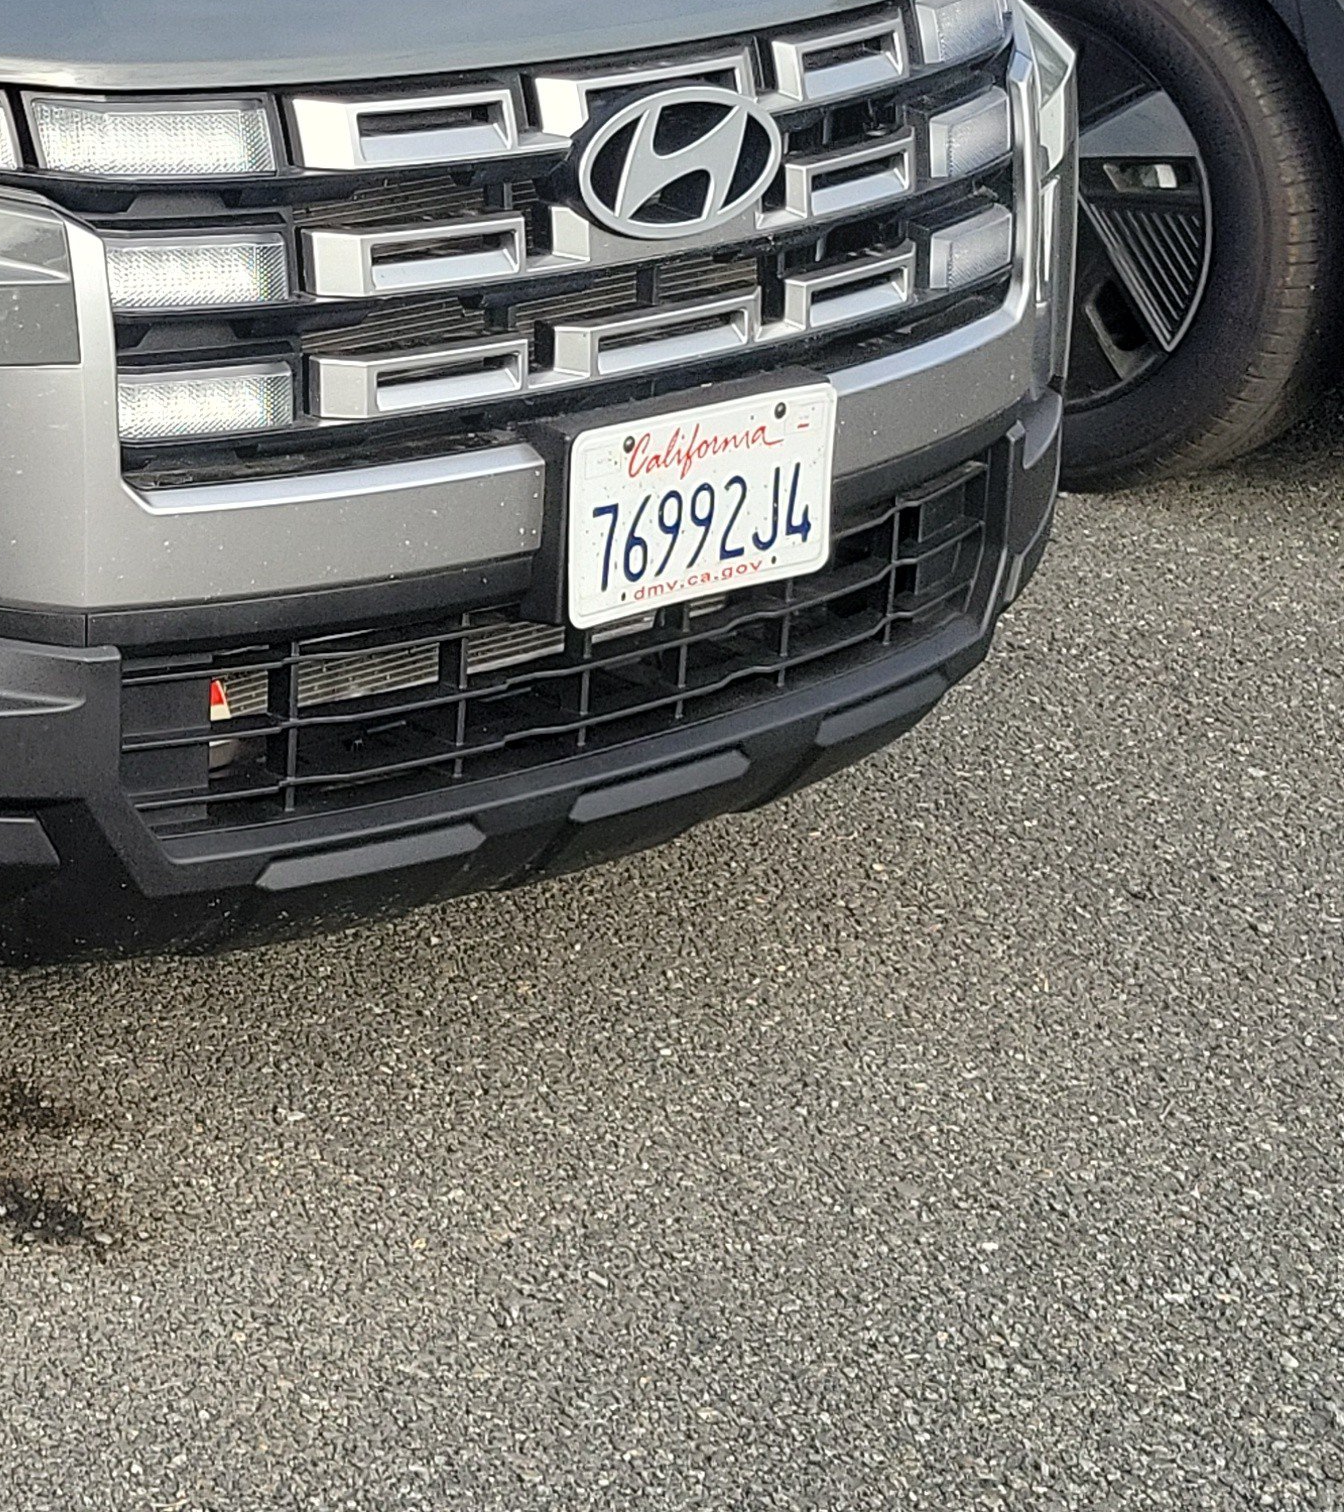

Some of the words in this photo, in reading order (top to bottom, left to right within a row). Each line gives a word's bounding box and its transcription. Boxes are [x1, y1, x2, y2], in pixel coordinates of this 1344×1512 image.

[628, 423, 783, 479] California
[593, 462, 811, 593] 76992J4
[634, 560, 762, 600] dmv.ca.gov
